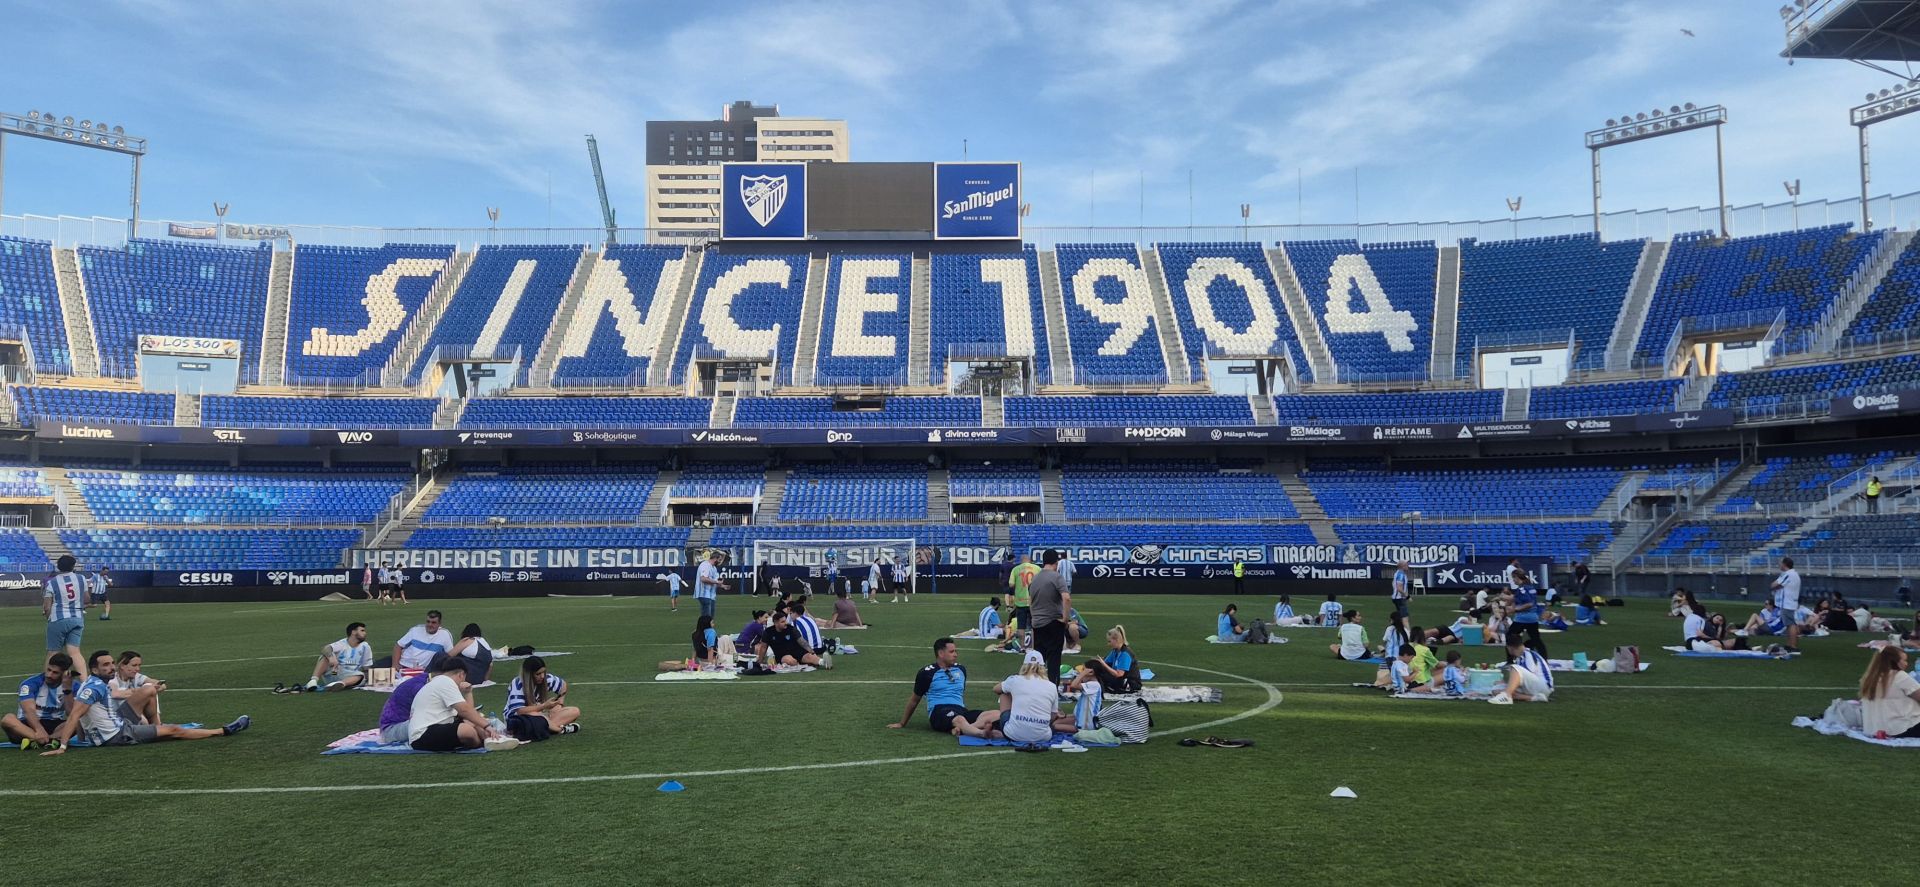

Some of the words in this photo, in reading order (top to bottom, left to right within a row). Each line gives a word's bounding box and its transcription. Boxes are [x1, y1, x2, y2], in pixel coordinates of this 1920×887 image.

[163, 339, 190, 348] LOS
[193, 341, 221, 349] 300
[473, 432, 513, 440] trevenque
[944, 430, 970, 438] divina
[970, 430, 998, 438] events
[1224, 430, 1246, 438] Málaga
[1247, 431, 1269, 439] Wagen
[1305, 427, 1341, 437] Málaga
[1384, 427, 1432, 436] RÉNTAME
[708, 432, 741, 442] Halcón
[364, 549, 501, 568] HEREDEROS
[510, 549, 541, 567] DE
[547, 549, 580, 567] UN
[588, 549, 680, 568] ESCUDO
[1169, 547, 1262, 562] HINCHAS
[1114, 567, 1185, 577] SERES
[1312, 566, 1371, 579] hummel
[179, 573, 233, 583] CESUR
[288, 570, 350, 585] hummel
[65, 583, 75, 602] 5
